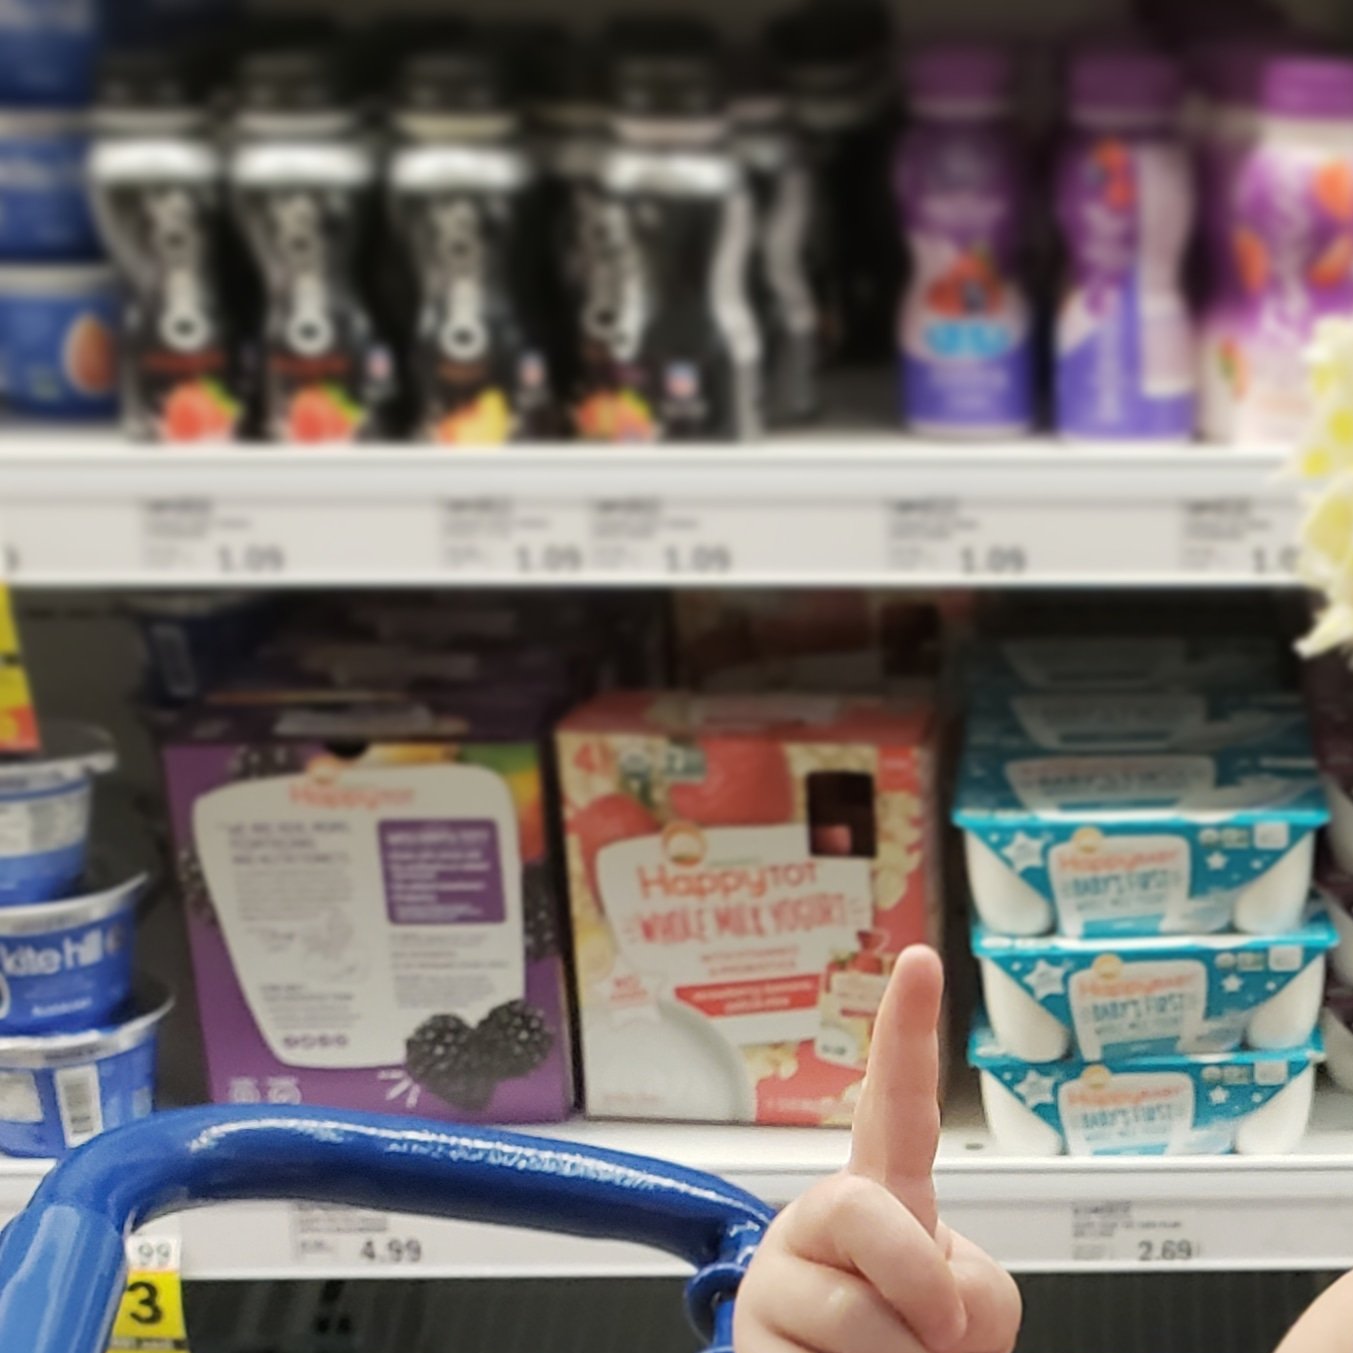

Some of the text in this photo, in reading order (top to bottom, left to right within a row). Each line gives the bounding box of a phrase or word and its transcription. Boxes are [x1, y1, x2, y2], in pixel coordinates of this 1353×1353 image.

[218, 545, 285, 573] 1.09
[515, 545, 582, 573] 1.09
[664, 545, 731, 573] 1.09
[960, 546, 1027, 574] 1.09
[1252, 546, 1300, 574] 1.0
[714, 903, 765, 937] MILK
[360, 1238, 423, 1264] 4.99
[1137, 1239, 1193, 1262] 2.69
